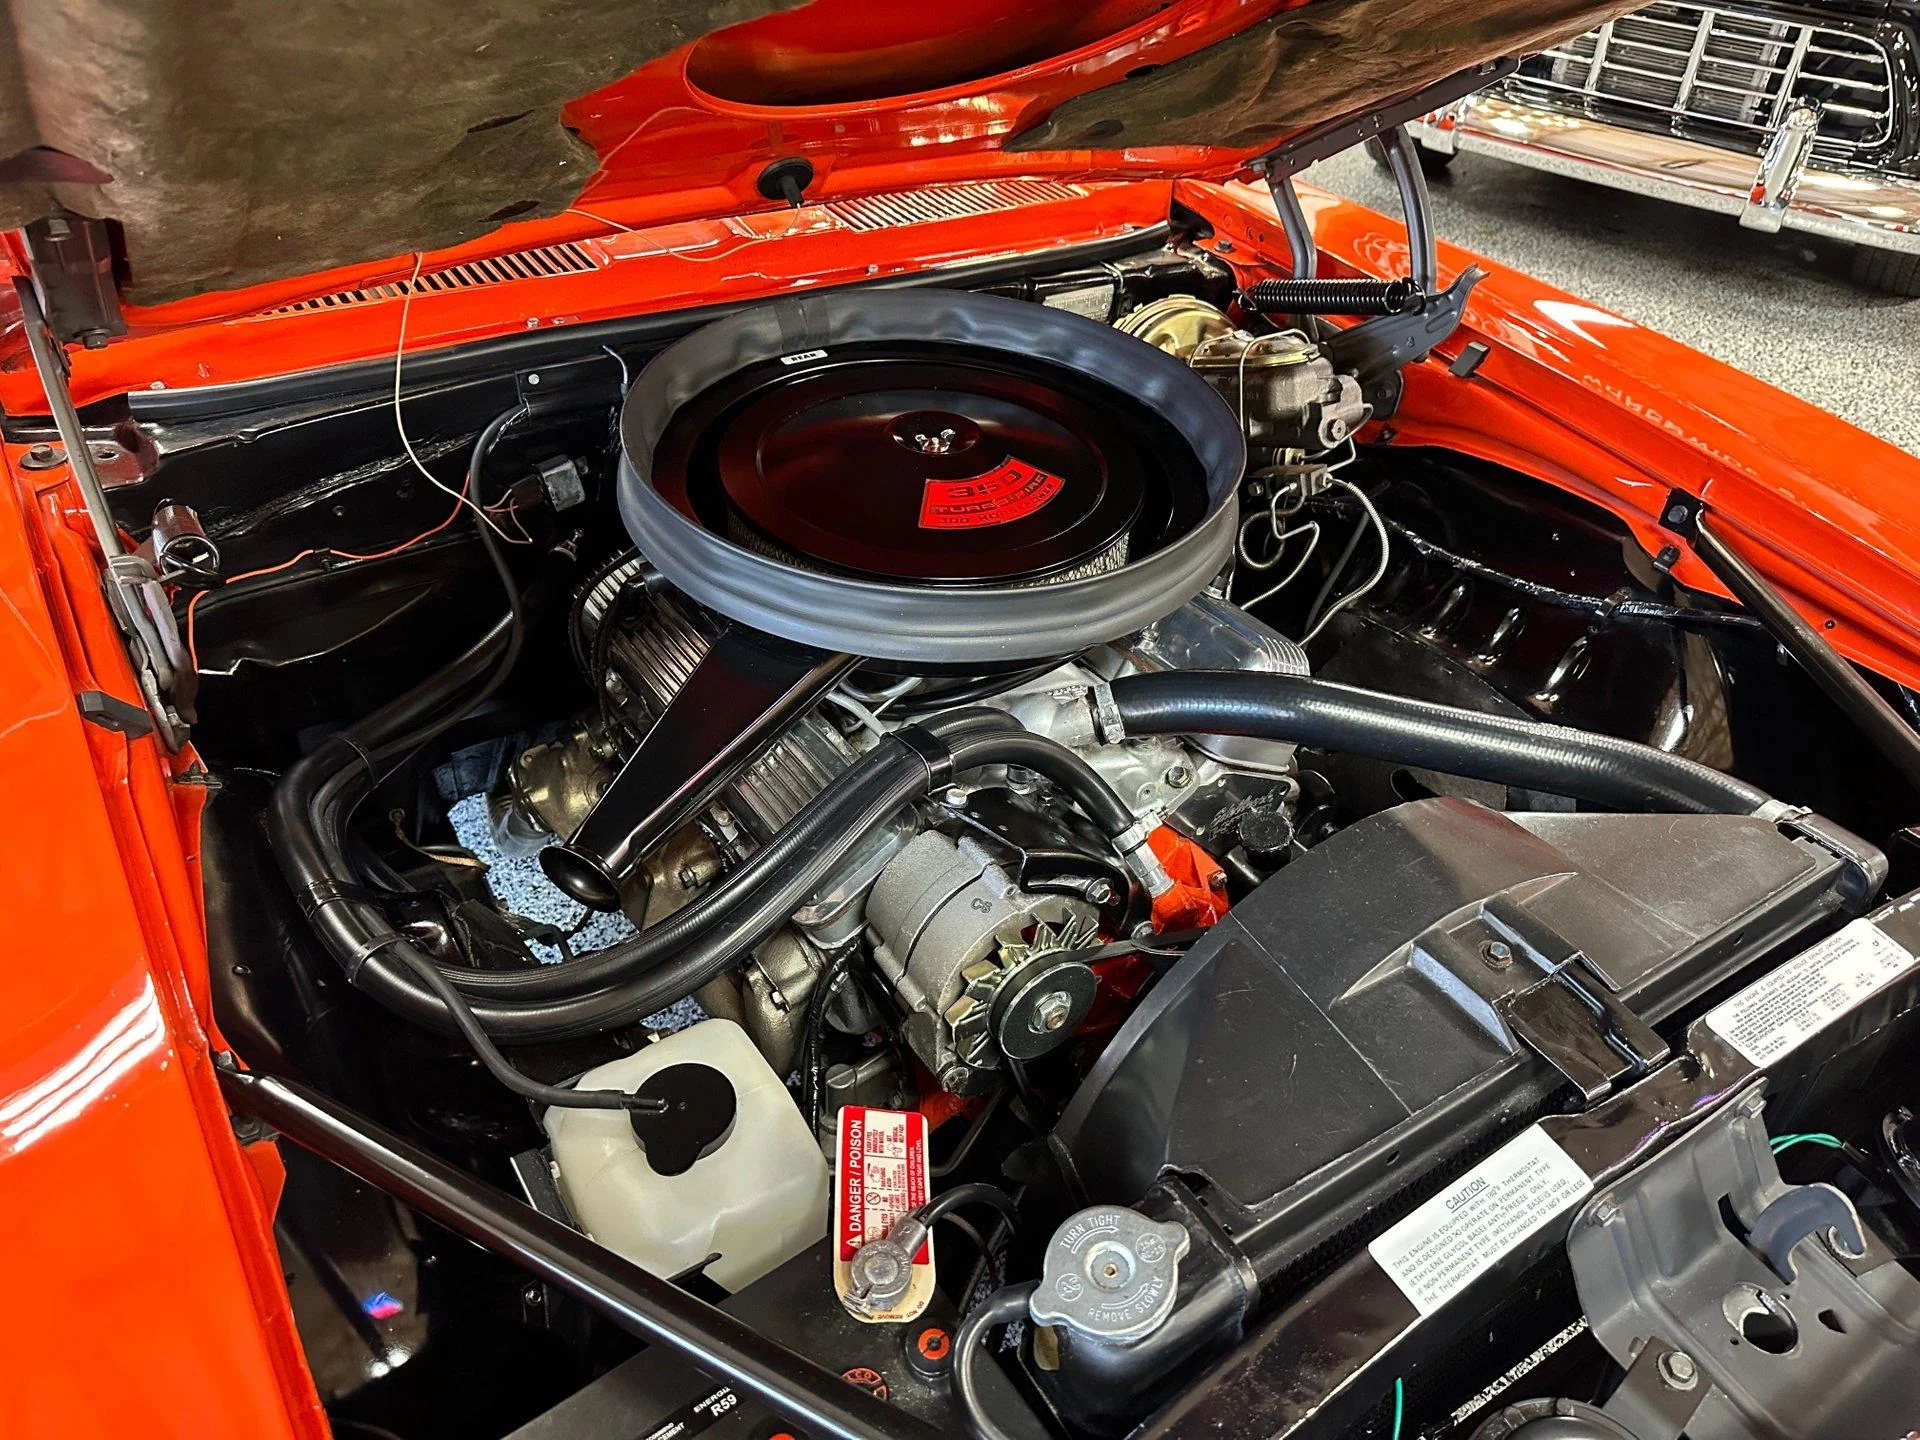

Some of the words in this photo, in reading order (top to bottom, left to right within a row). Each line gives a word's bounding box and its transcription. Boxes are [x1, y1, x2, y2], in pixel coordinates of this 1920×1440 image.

[948, 469, 1023, 499] 350
[849, 1119, 862, 1168] POISON
[848, 1177, 862, 1231] DANGER
[1392, 1255, 1409, 1268] THIS
[1408, 1236, 1432, 1257] ENGINE
[1431, 1231, 1439, 1239] IS
[1438, 1210, 1468, 1234] EQUIPPED
[1469, 1198, 1485, 1211] WITH
[1501, 1156, 1539, 1186] THERMOSTAT
[1445, 1176, 1486, 1209] CAUTION
[1060, 1224, 1086, 1248] TURN
[1087, 1214, 1120, 1227] TIGHT
[1401, 1263, 1416, 1277] AND
[1421, 1235, 1453, 1261] DESIGNED
[1460, 1208, 1489, 1231] OPERATE
[1488, 1201, 1499, 1210] ON
[1497, 1175, 1534, 1203] PERMANENT
[1534, 1162, 1550, 1176] TYPE
[1423, 1291, 1438, 1304] THE
[1438, 1257, 1479, 1292] THERMOSTAT
[1481, 1242, 1499, 1258] MUST
[1498, 1236, 1509, 1246] BE
[1508, 1214, 1537, 1239] CHANGED
[1535, 1207, 1546, 1216] TO
[1560, 1189, 1571, 1198] OR
[1569, 1179, 1585, 1192] LESS
[1442, 1239, 1468, 1259] GLYCOL
[1473, 1234, 1490, 1249] TYPE
[1088, 1308, 1132, 1322] REMOVE
[1134, 1276, 1164, 1314] SLOWLY
[710, 1393, 737, 1417] R59
